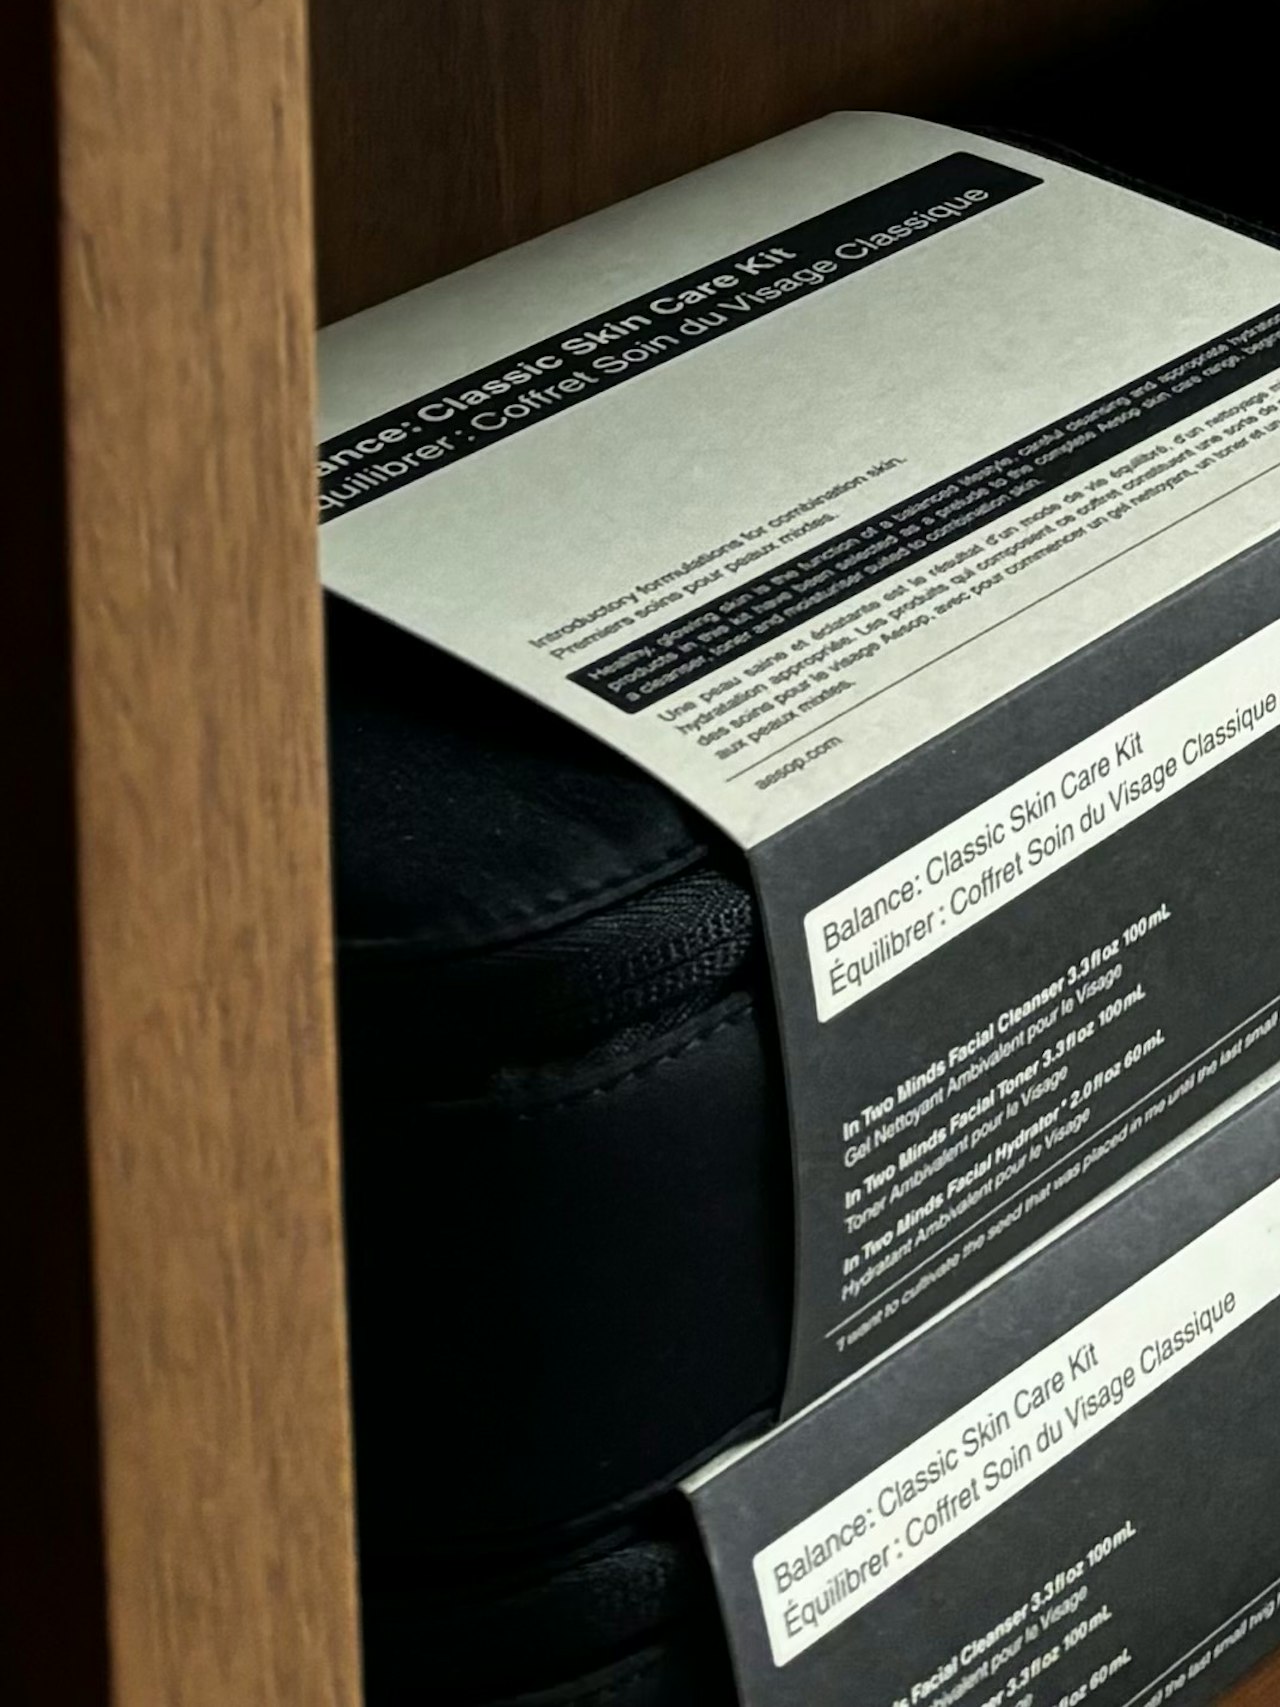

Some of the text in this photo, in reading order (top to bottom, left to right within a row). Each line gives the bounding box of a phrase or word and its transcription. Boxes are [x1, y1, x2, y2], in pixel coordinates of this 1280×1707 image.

[318, 184, 991, 515] quilibrer Coffret Soin du Visage Classique
[318, 243, 799, 479] ance: Classic Skin Care Kit
[822, 729, 1147, 954] Balance: Classic Skin Care Kit
[827, 687, 1279, 999] Équilibrer Coffret Soin du Visage Classique
[841, 977, 1065, 1142] In Two Minds Facial Cleanser
[773, 1341, 1101, 1597] Balance: Classic Skin Care Kit
[783, 1288, 1239, 1640] Équilibrer Coffret Soin du Visage Classique
